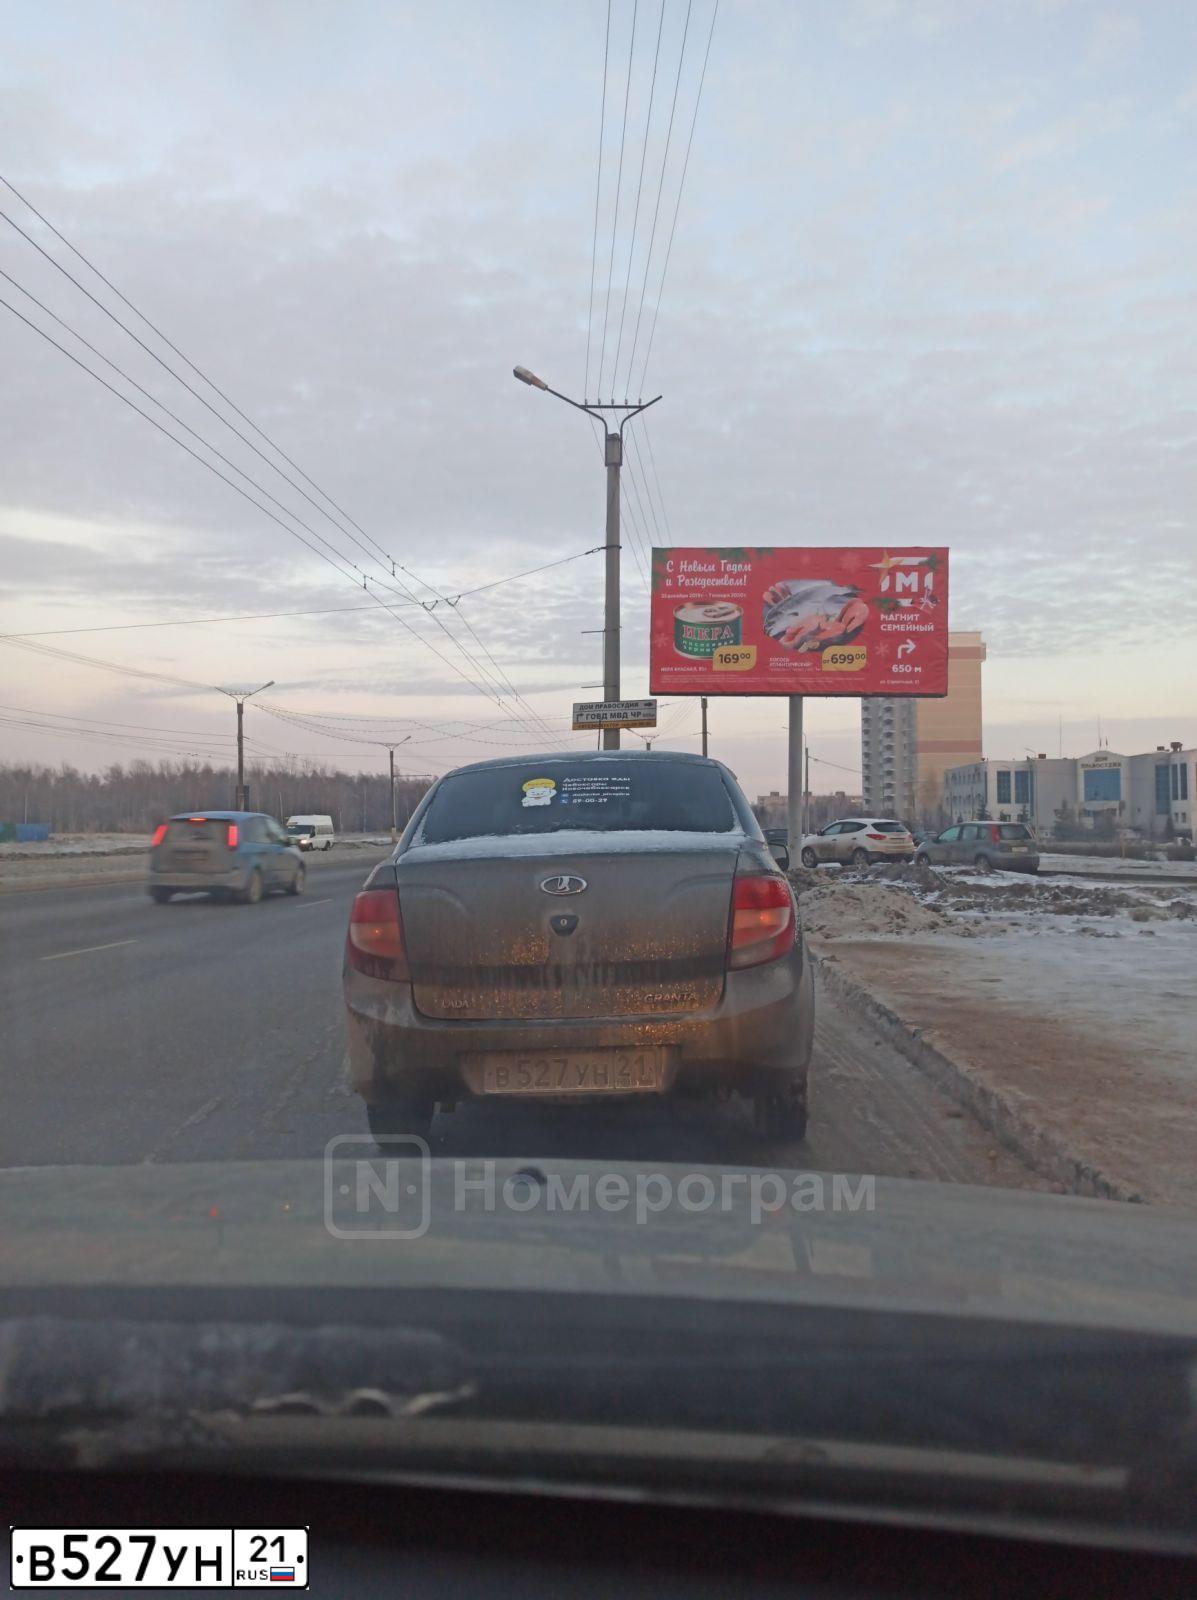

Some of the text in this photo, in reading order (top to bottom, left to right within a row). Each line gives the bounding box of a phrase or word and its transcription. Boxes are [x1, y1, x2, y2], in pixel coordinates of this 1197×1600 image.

[666, 560, 752, 573] С Новым Годом
[677, 574, 747, 588] Рождеством!
[880, 613, 920, 621] МАГНИТ
[880, 622, 934, 632] СЕМЕЙНЫЙ
[682, 625, 734, 640] ИКРА
[831, 653, 854, 664] 699
[892, 664, 911, 673] 650
[595, 702, 639, 710] ПРАВОСУДИЯ
[586, 712, 608, 720] ГОВД
[609, 712, 628, 720] МВД
[616, 1055, 645, 1077] 21
